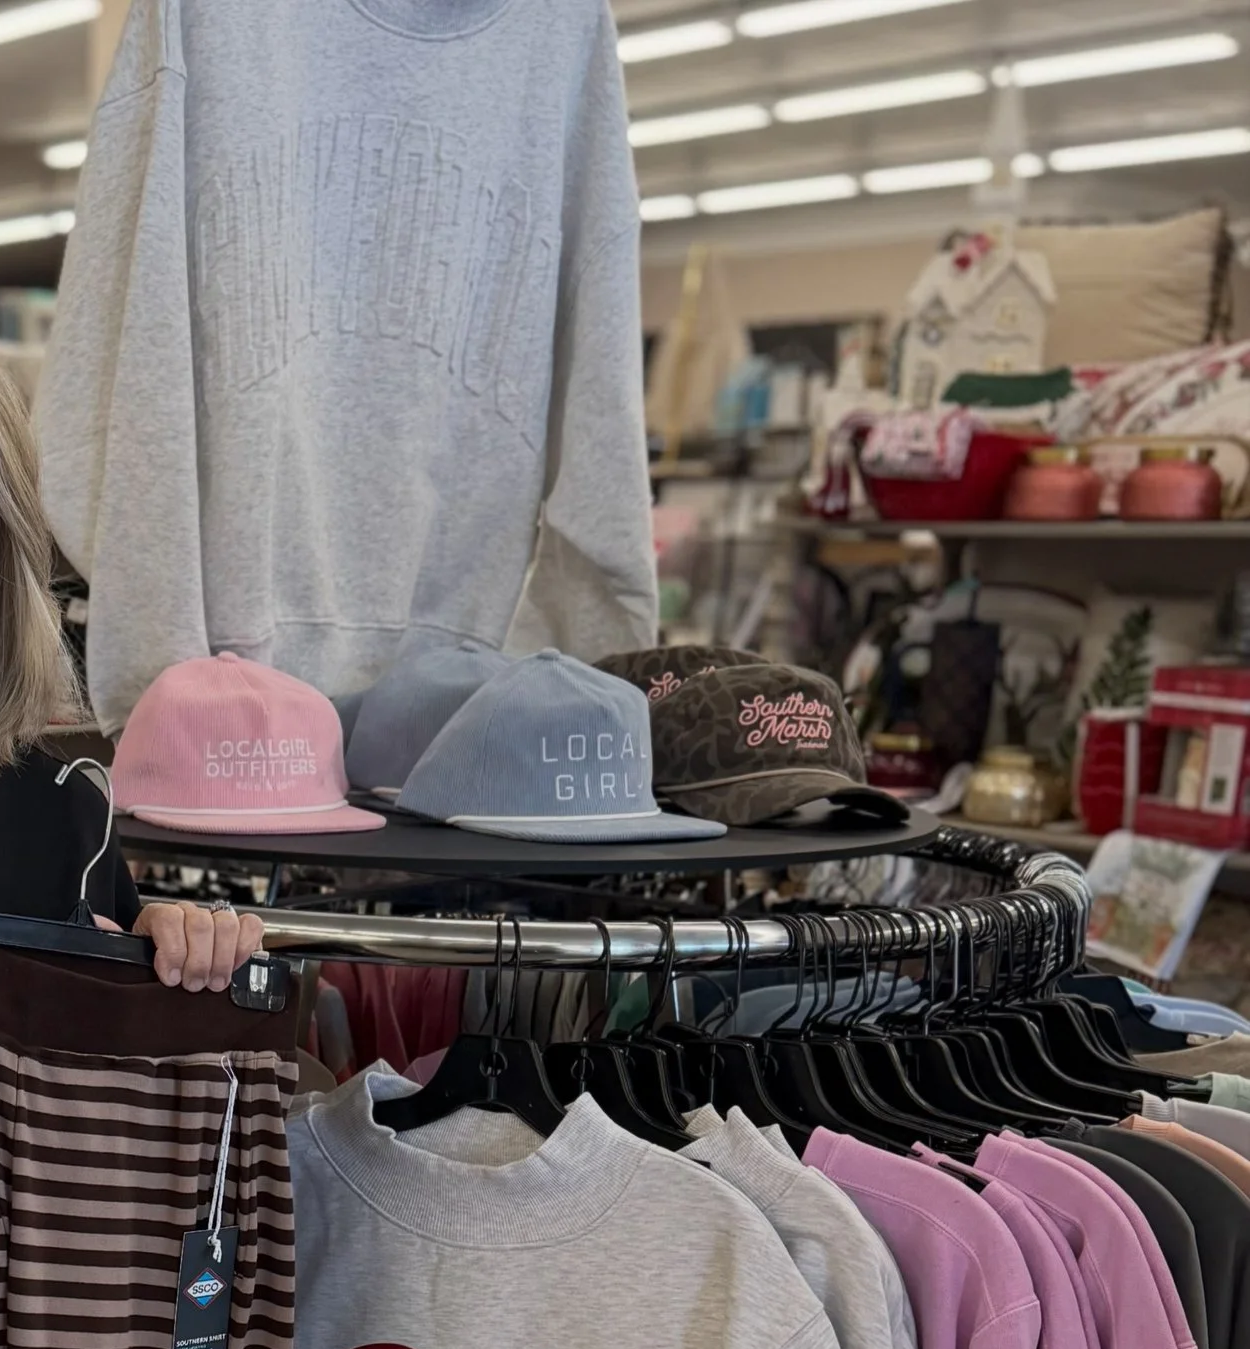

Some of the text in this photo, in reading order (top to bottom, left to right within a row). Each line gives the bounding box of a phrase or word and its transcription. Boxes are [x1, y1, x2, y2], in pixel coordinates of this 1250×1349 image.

[738, 691, 834, 726] Southern
[747, 716, 832, 746] Marsh
[206, 738, 317, 759] LOCALGIRL
[542, 732, 647, 762] LOCAL
[206, 759, 317, 778] OUTFITTERS
[556, 772, 637, 801] GIRL
[192, 1282, 219, 1295] SSCO
[176, 1336, 209, 1348] SOUTHERN
